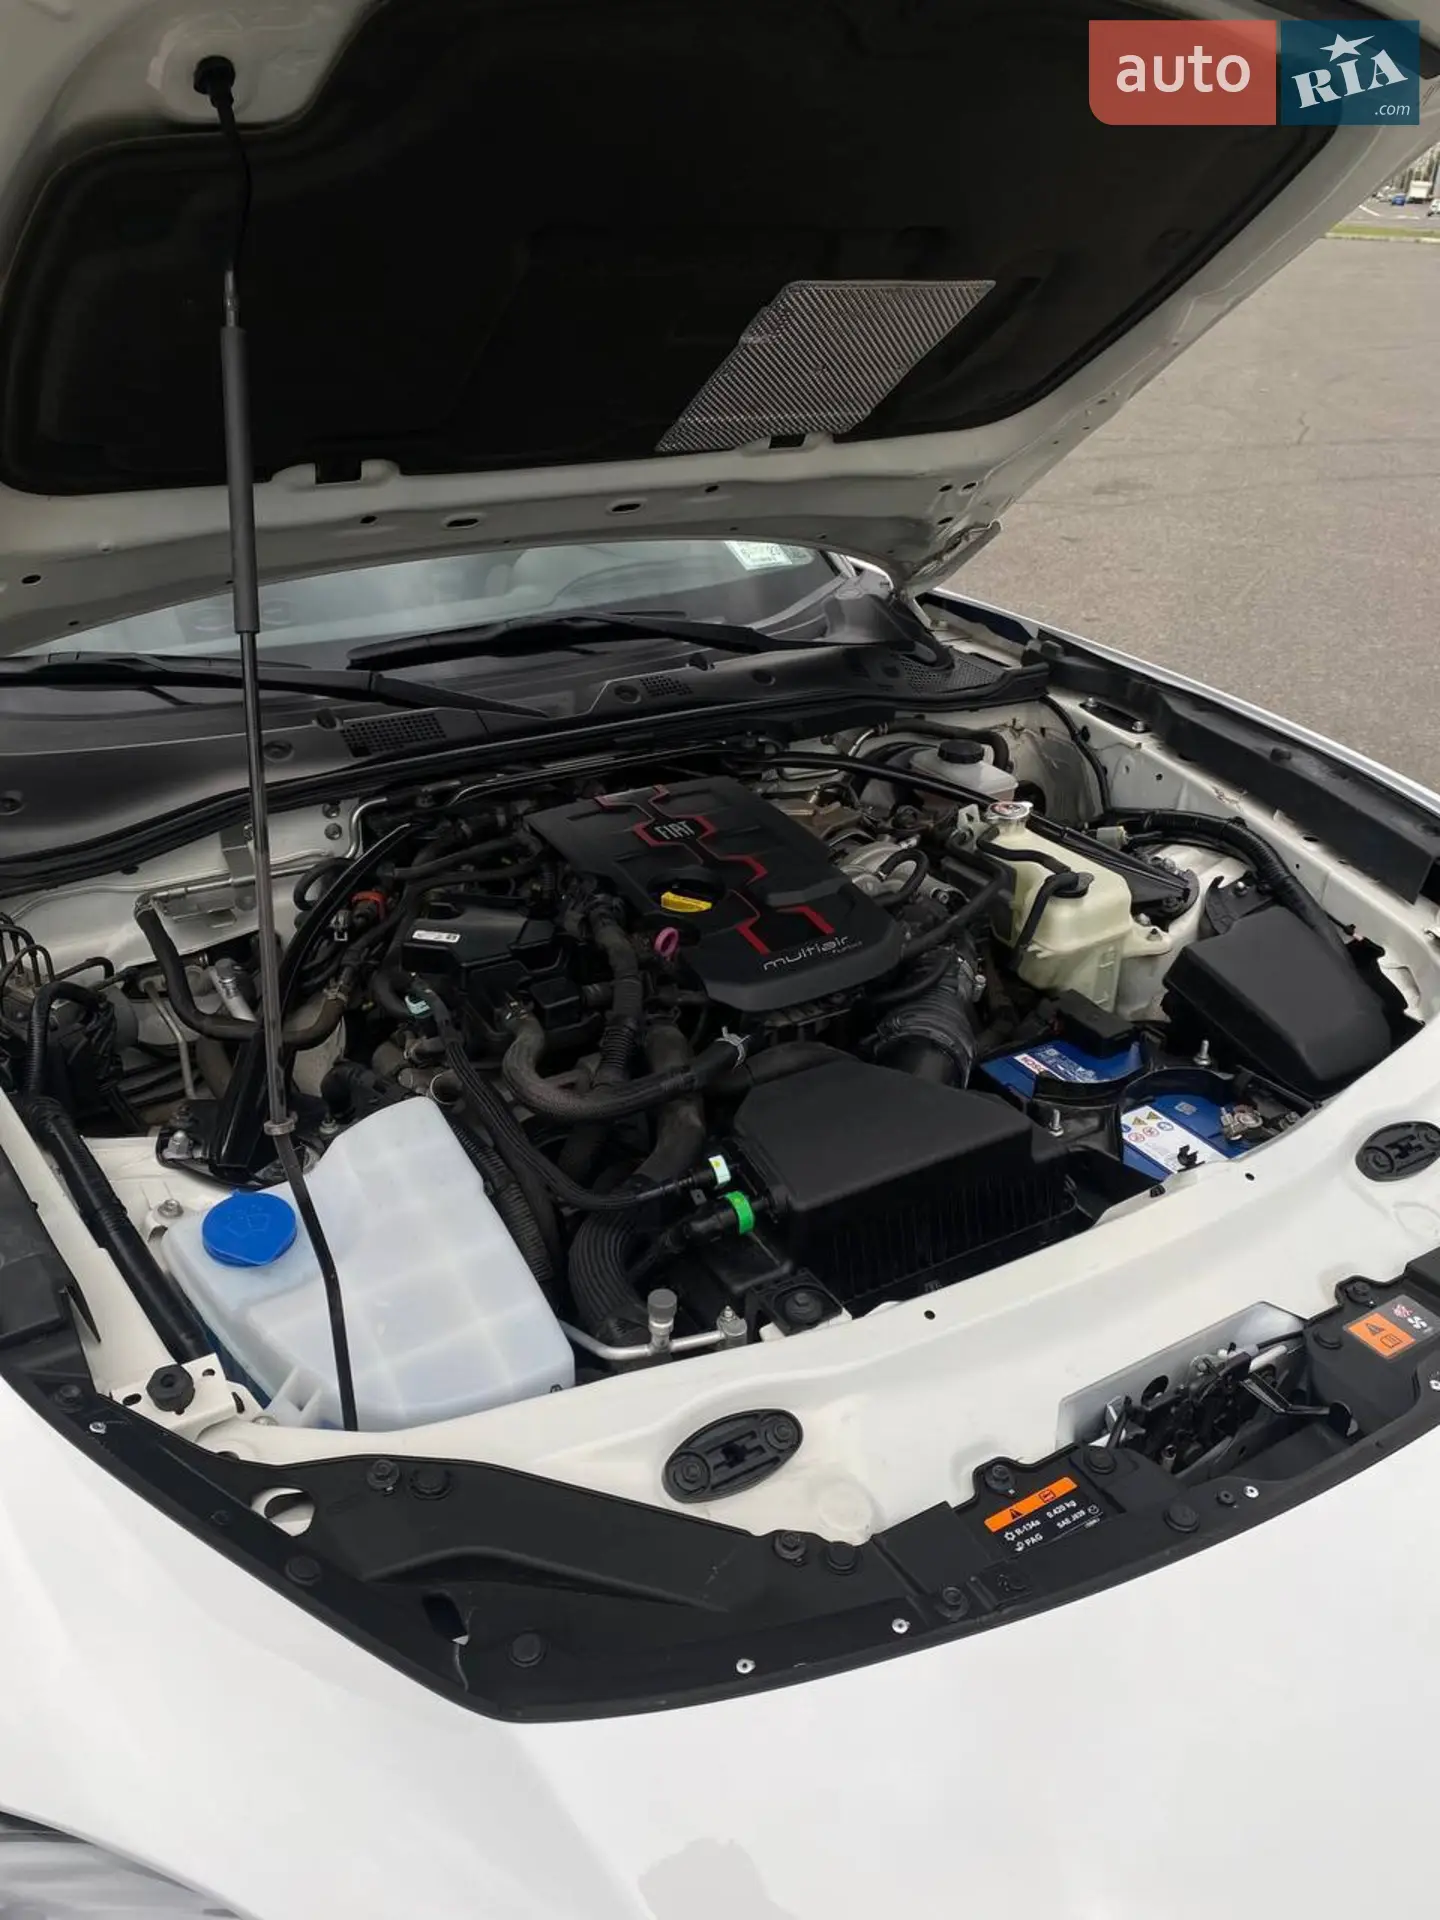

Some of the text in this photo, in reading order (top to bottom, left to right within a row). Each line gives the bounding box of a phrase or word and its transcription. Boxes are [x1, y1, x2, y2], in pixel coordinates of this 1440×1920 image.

[654, 820, 696, 841] FIAT
[763, 935, 852, 971] multiair
[1024, 1533, 1043, 1548] PAG
